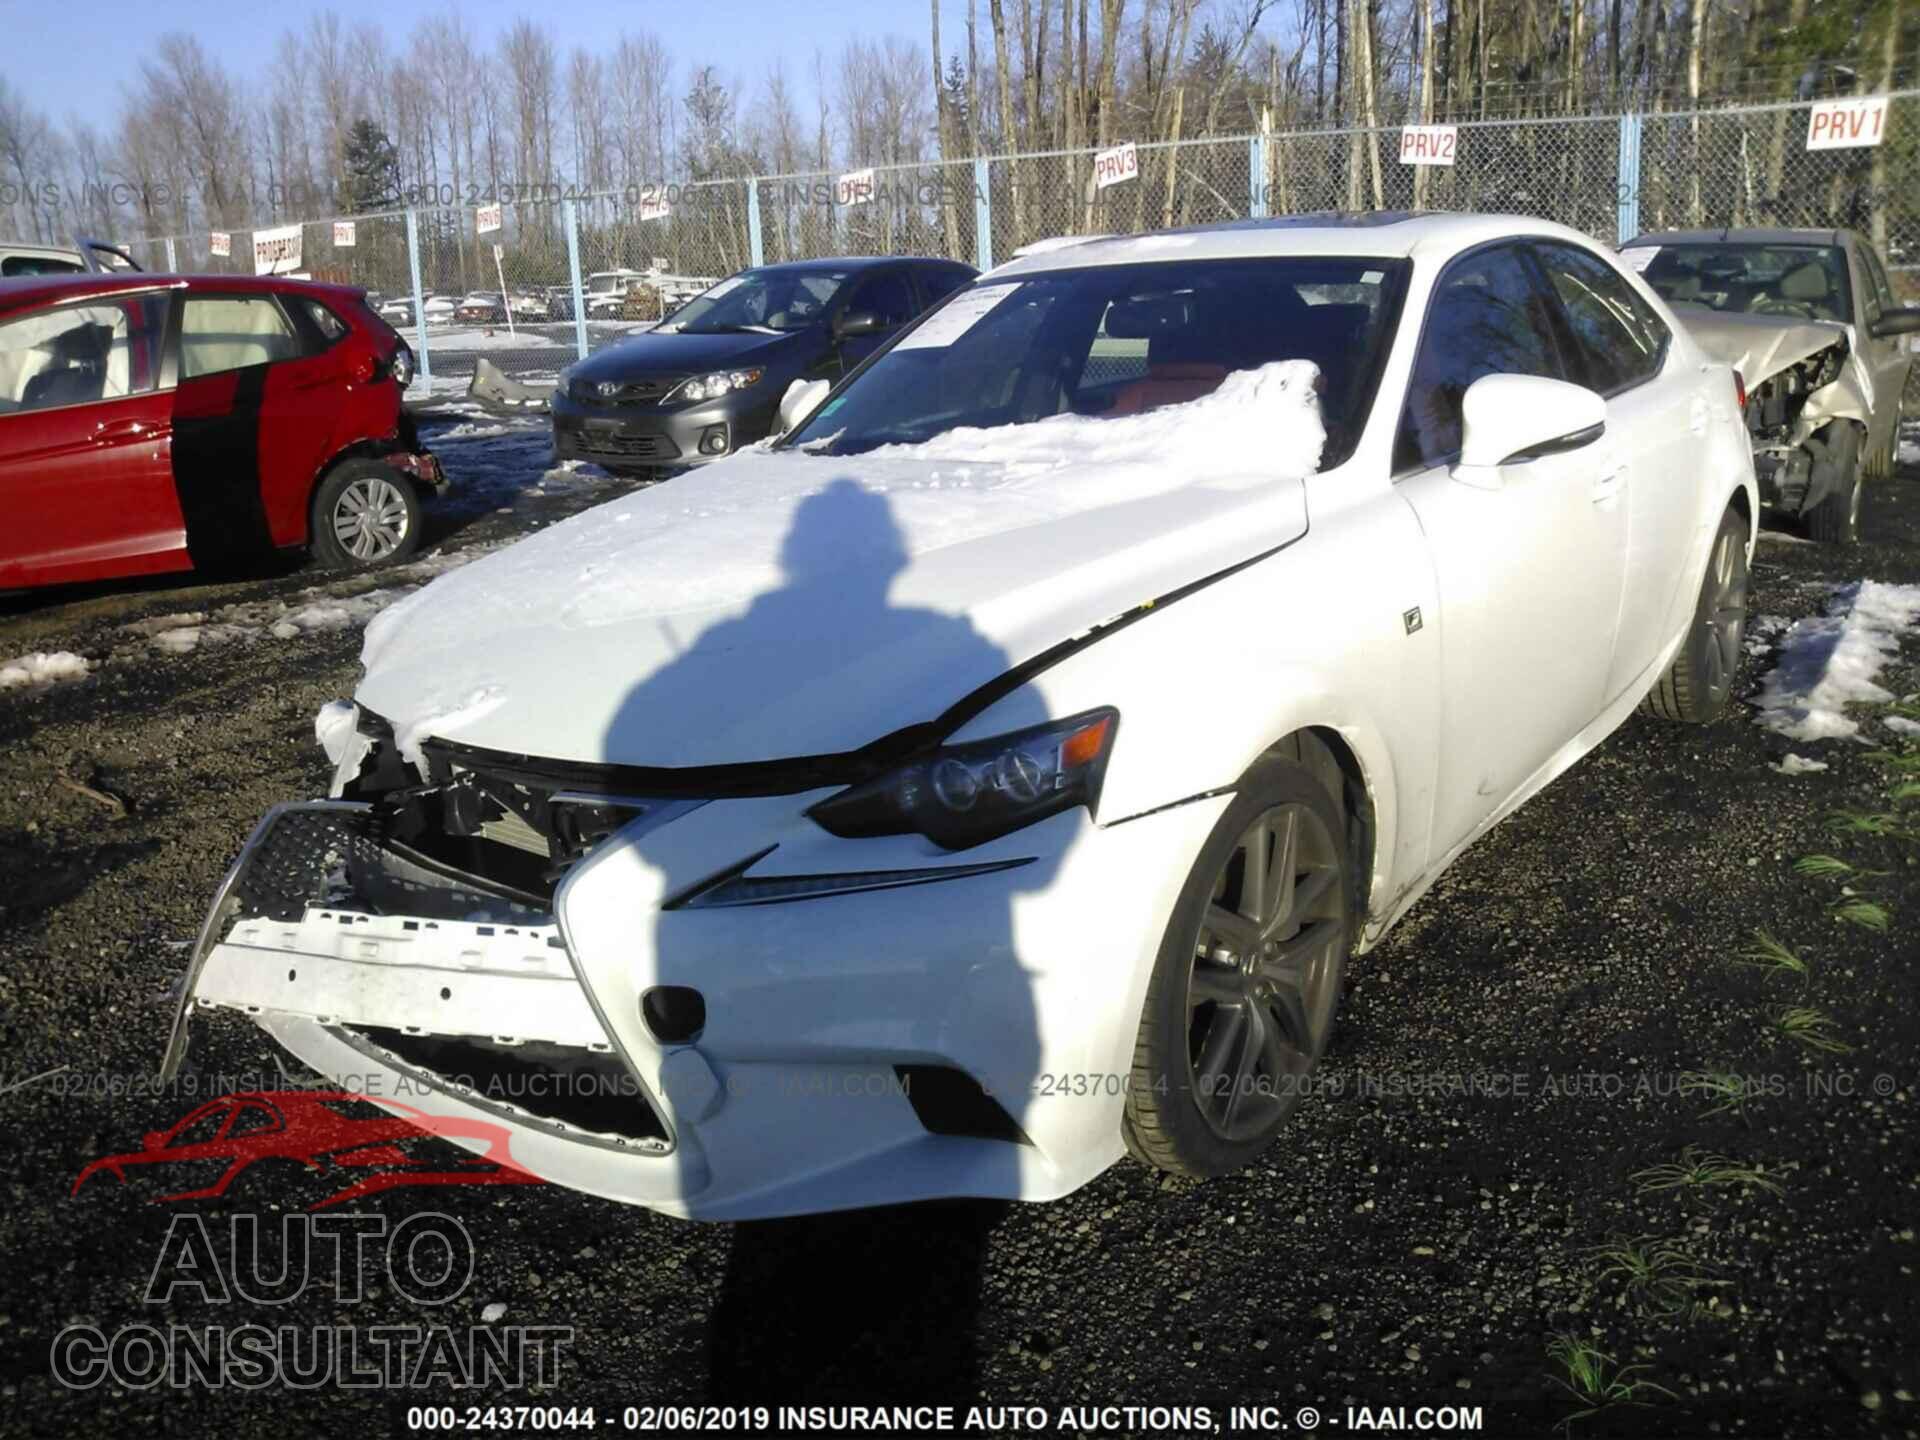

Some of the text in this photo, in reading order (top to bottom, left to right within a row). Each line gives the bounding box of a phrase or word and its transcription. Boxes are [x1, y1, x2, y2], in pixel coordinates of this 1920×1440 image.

[1812, 108, 1883, 141] PRV1
[1403, 133, 1454, 157] PRV2
[1097, 150, 1136, 181] PRV3
